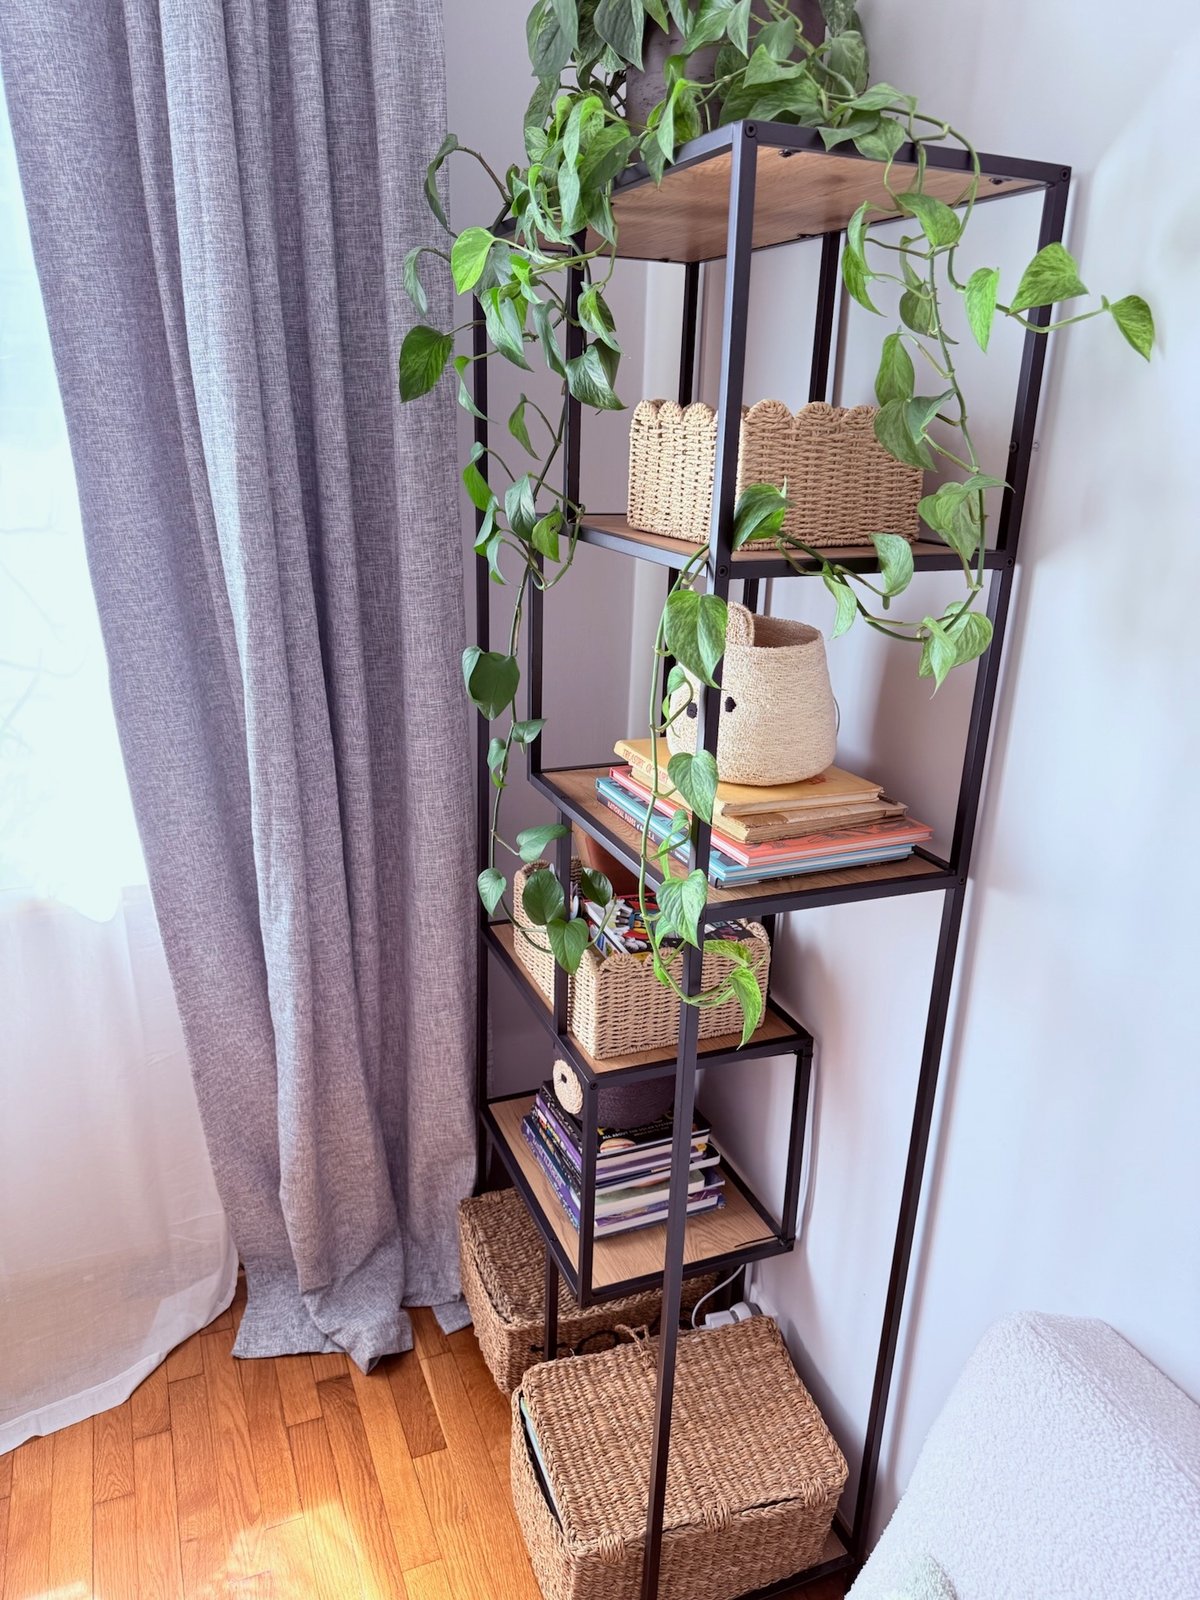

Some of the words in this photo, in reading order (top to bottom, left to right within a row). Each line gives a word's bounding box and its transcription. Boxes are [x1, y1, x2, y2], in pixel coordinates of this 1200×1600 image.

[622, 748, 646, 769] TREASURY
[607, 801, 624, 817] NATIONAL
[624, 813, 636, 827] PARKS
